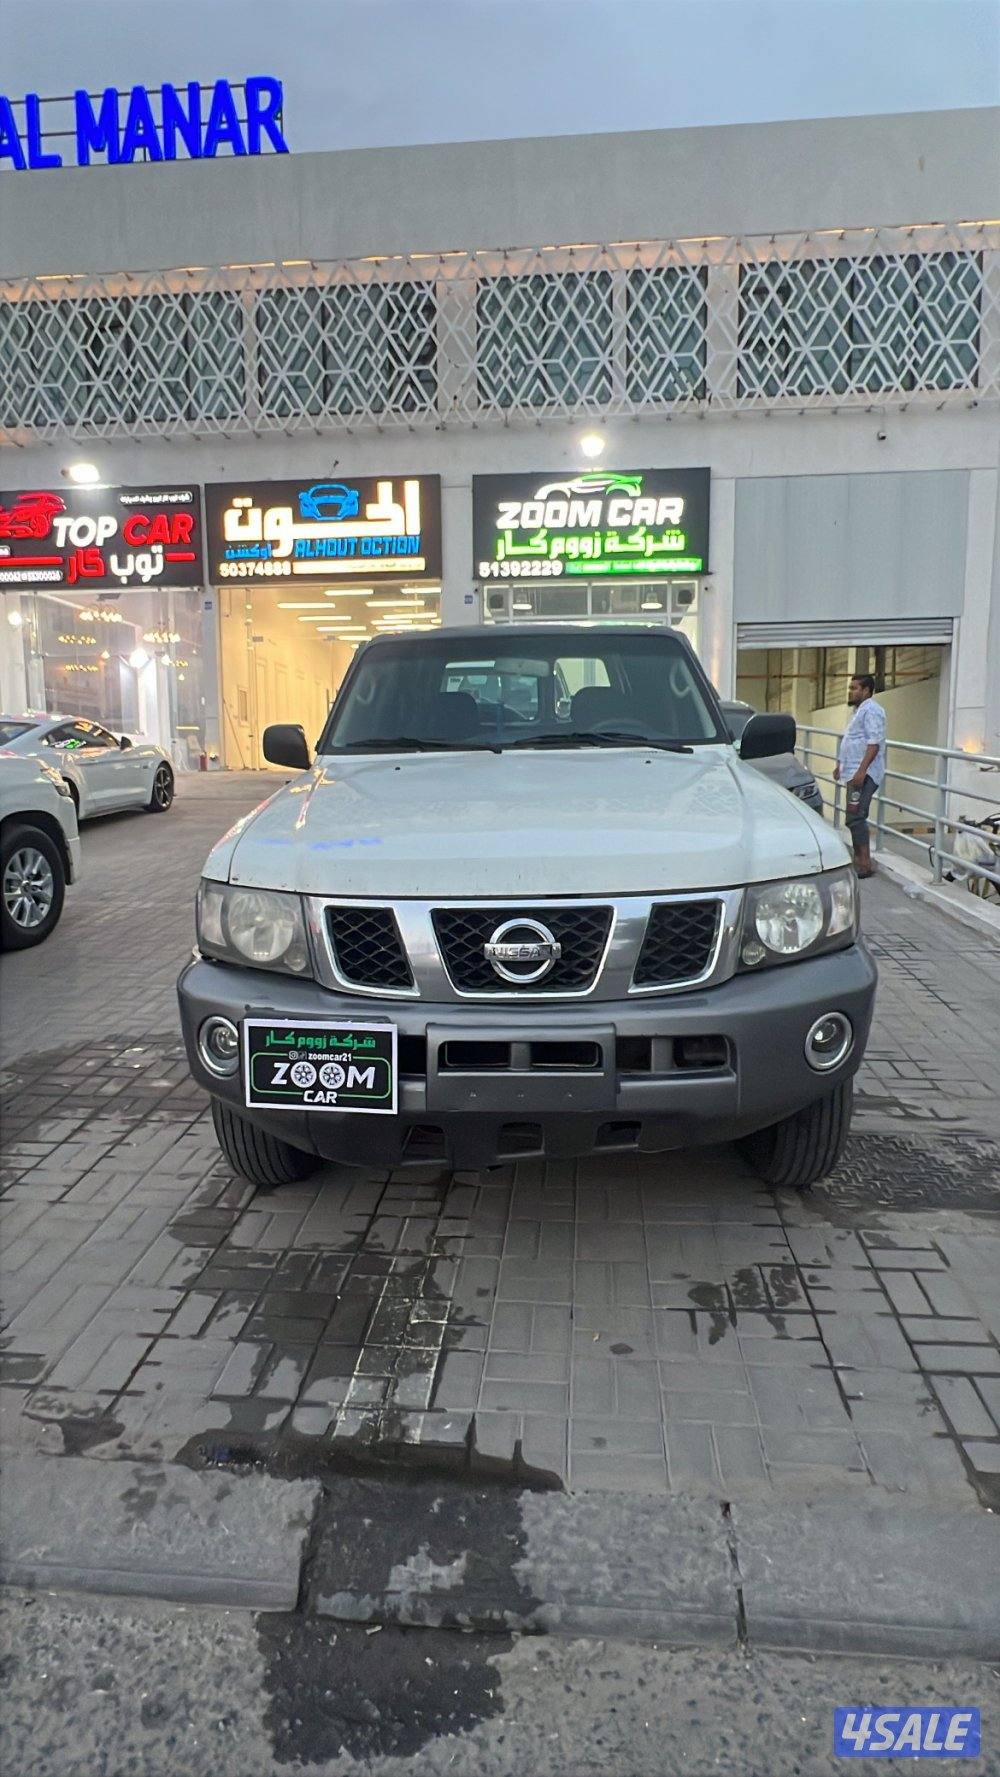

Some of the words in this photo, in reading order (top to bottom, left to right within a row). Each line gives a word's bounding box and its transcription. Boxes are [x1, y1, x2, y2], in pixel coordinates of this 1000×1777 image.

[75, 76, 290, 166] MANAR
[496, 500, 603, 529] ZOOM
[606, 497, 684, 527] CAR
[53, 516, 118, 548] TOP
[123, 513, 194, 547] CAR
[495, 528, 548, 560] كار
[604, 526, 685, 557] شركة
[294, 538, 358, 558] ALHOUT
[361, 535, 421, 557] OCTION
[549, 531, 601, 559] زووم
[66, 547, 105, 585] كار
[110, 545, 164, 584] توب
[478, 560, 564, 578] 51392229
[265, 1030, 296, 1047] كار
[297, 1034, 327, 1049] زووم
[329, 1033, 376, 1050] شركة
[308, 1053, 352, 1062] zoomcar21
[270, 1061, 376, 1090] ZOOM
[303, 1090, 338, 1104] CAR
